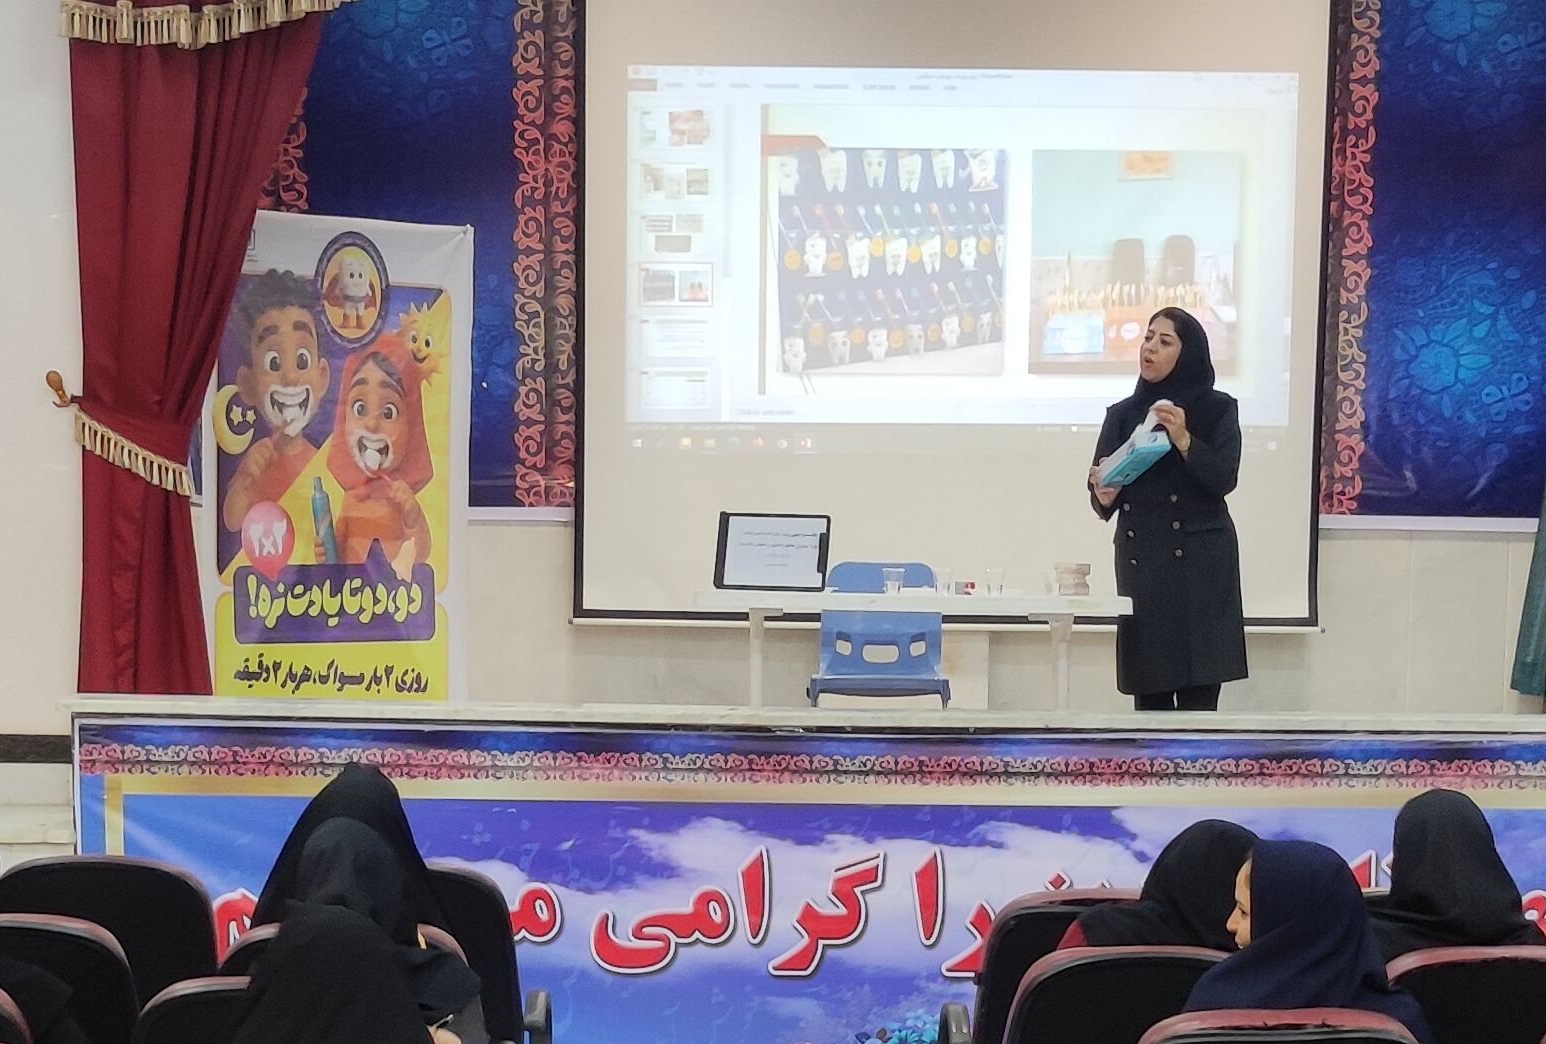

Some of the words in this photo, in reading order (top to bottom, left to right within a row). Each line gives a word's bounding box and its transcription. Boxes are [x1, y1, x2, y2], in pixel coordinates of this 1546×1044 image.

[233, 652, 271, 688] دقیقه
[272, 659, 283, 685] ۲
[365, 665, 383, 694] بار
[384, 664, 395, 689] ۲
[395, 666, 429, 693] روزی
[591, 846, 885, 977] گرامی
